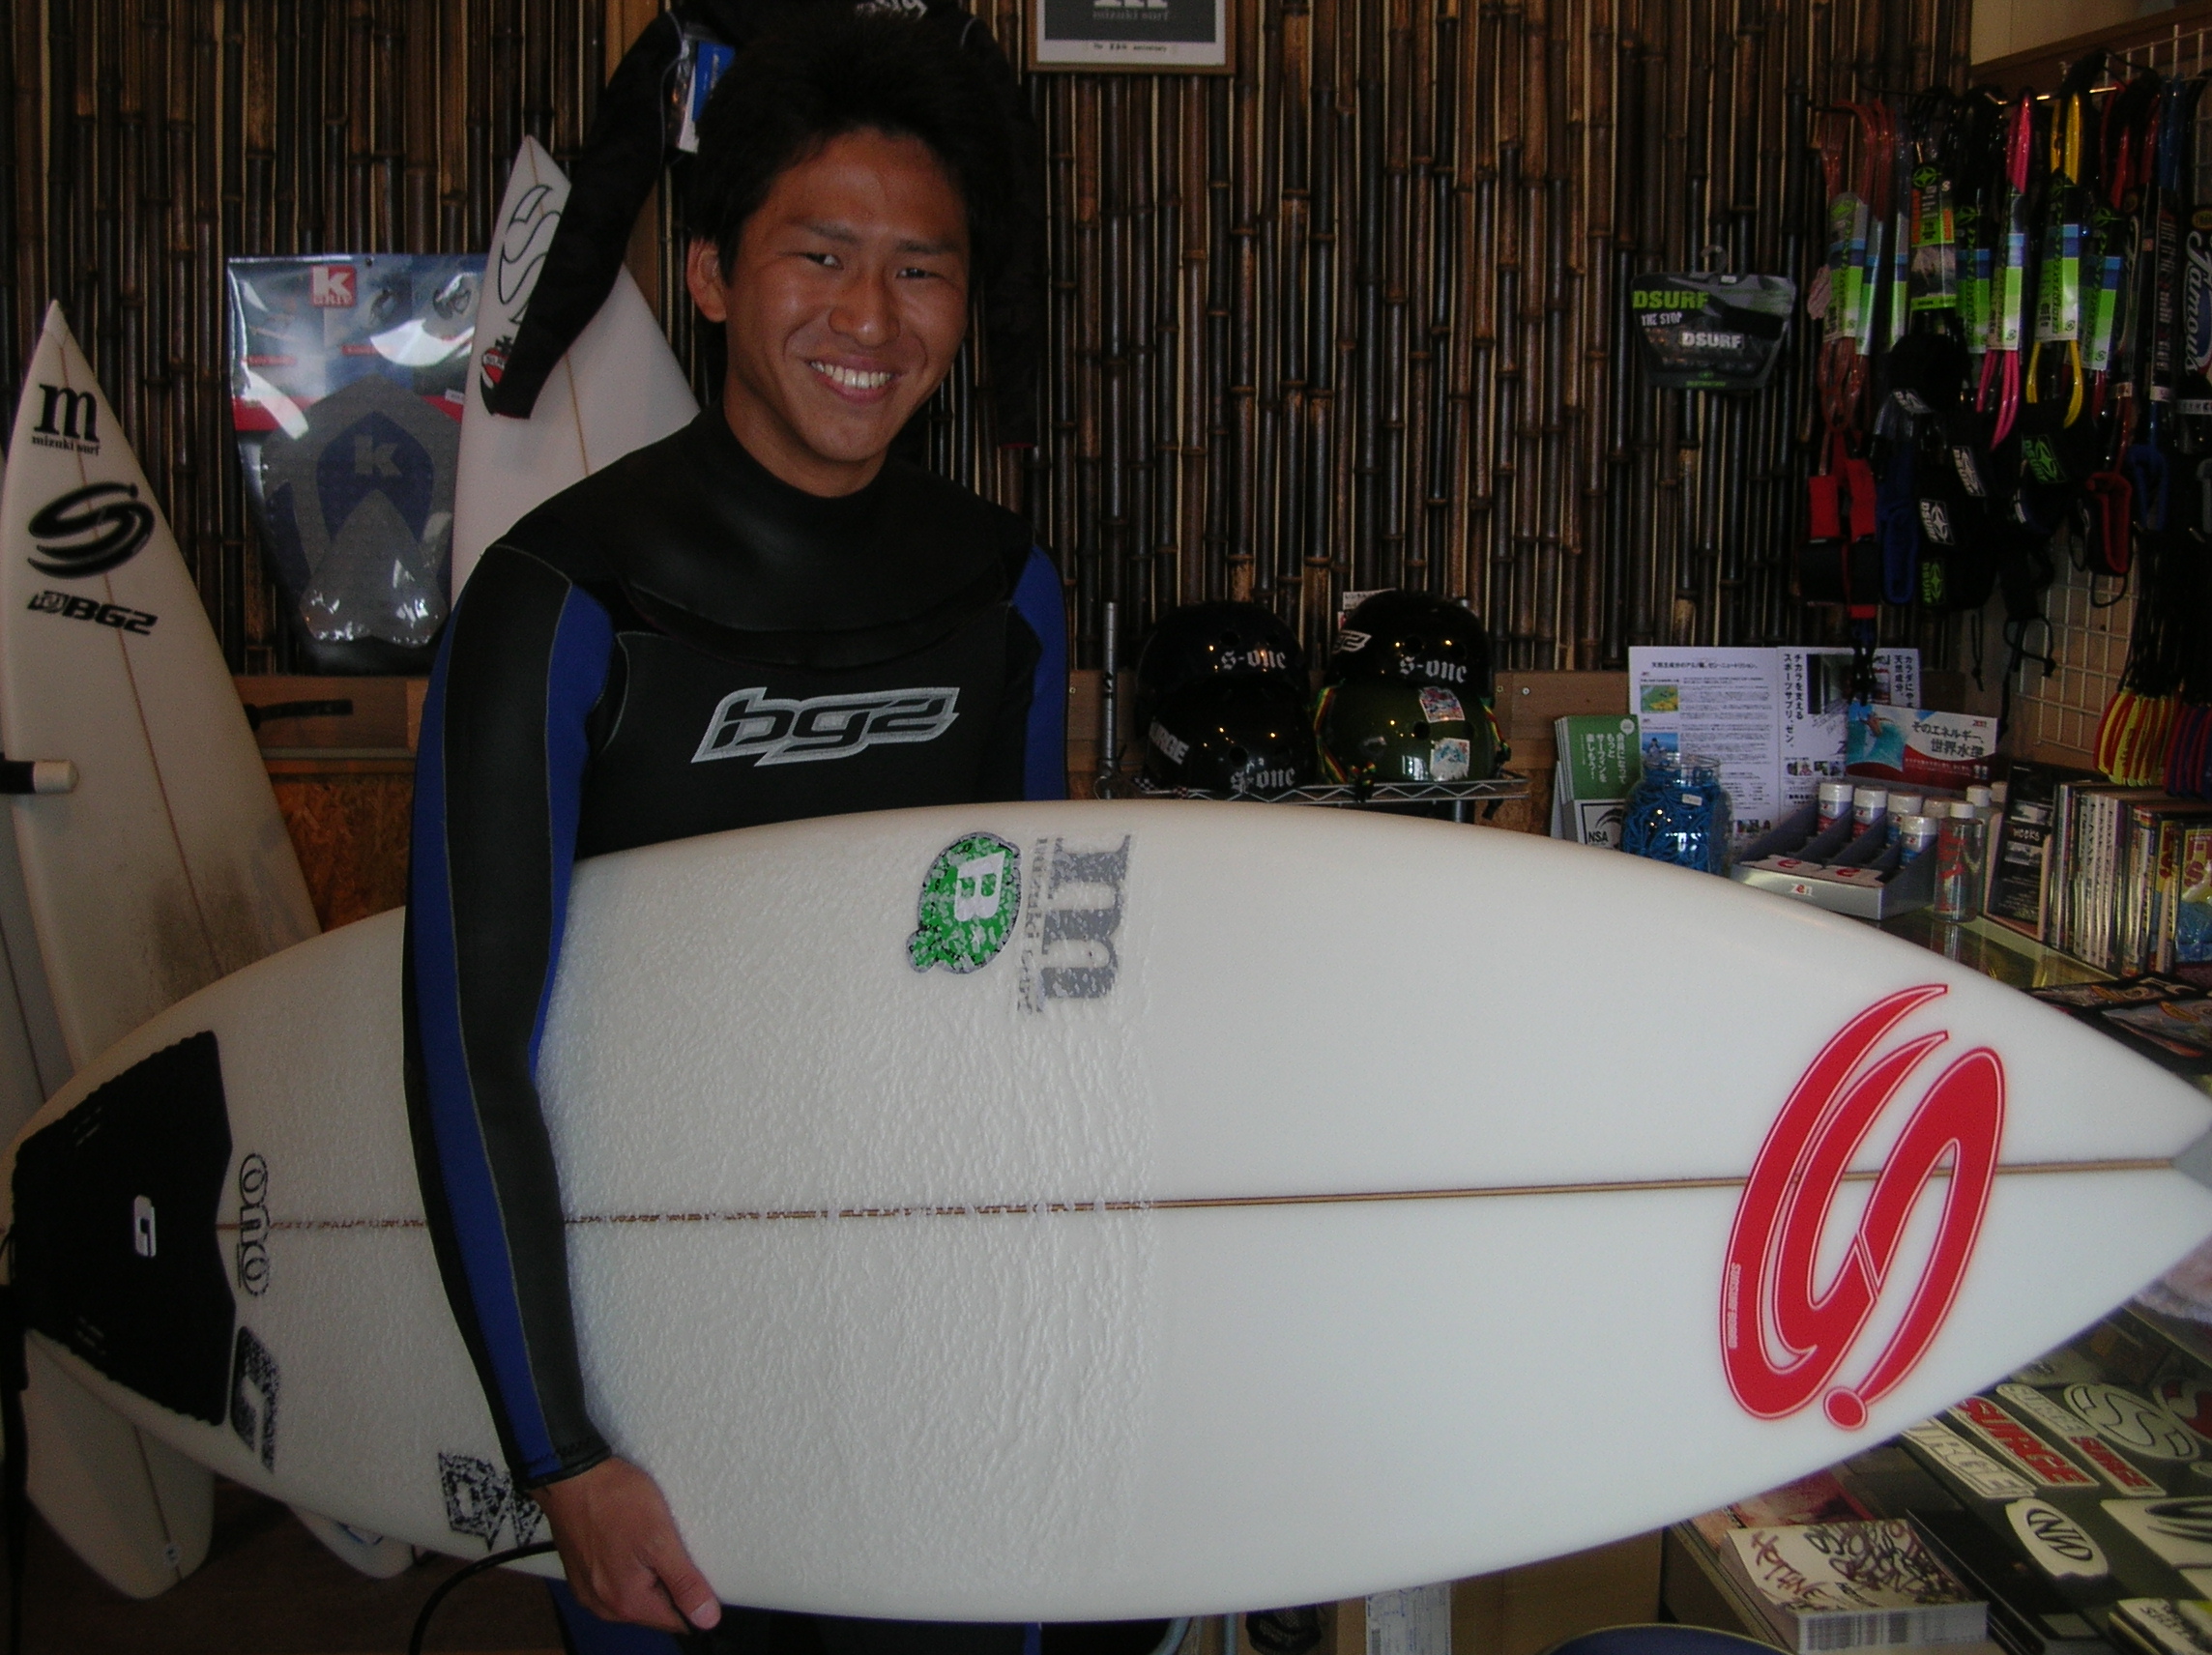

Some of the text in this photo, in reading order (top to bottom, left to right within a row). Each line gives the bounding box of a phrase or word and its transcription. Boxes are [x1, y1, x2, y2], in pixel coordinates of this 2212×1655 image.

[1632, 290, 1709, 310] DSURF
[1660, 310, 1684, 327] STOP
[1680, 330, 1744, 350] DSURF
[32, 435, 101, 456] mizuki surf
[1587, 831, 1610, 843] NSA
